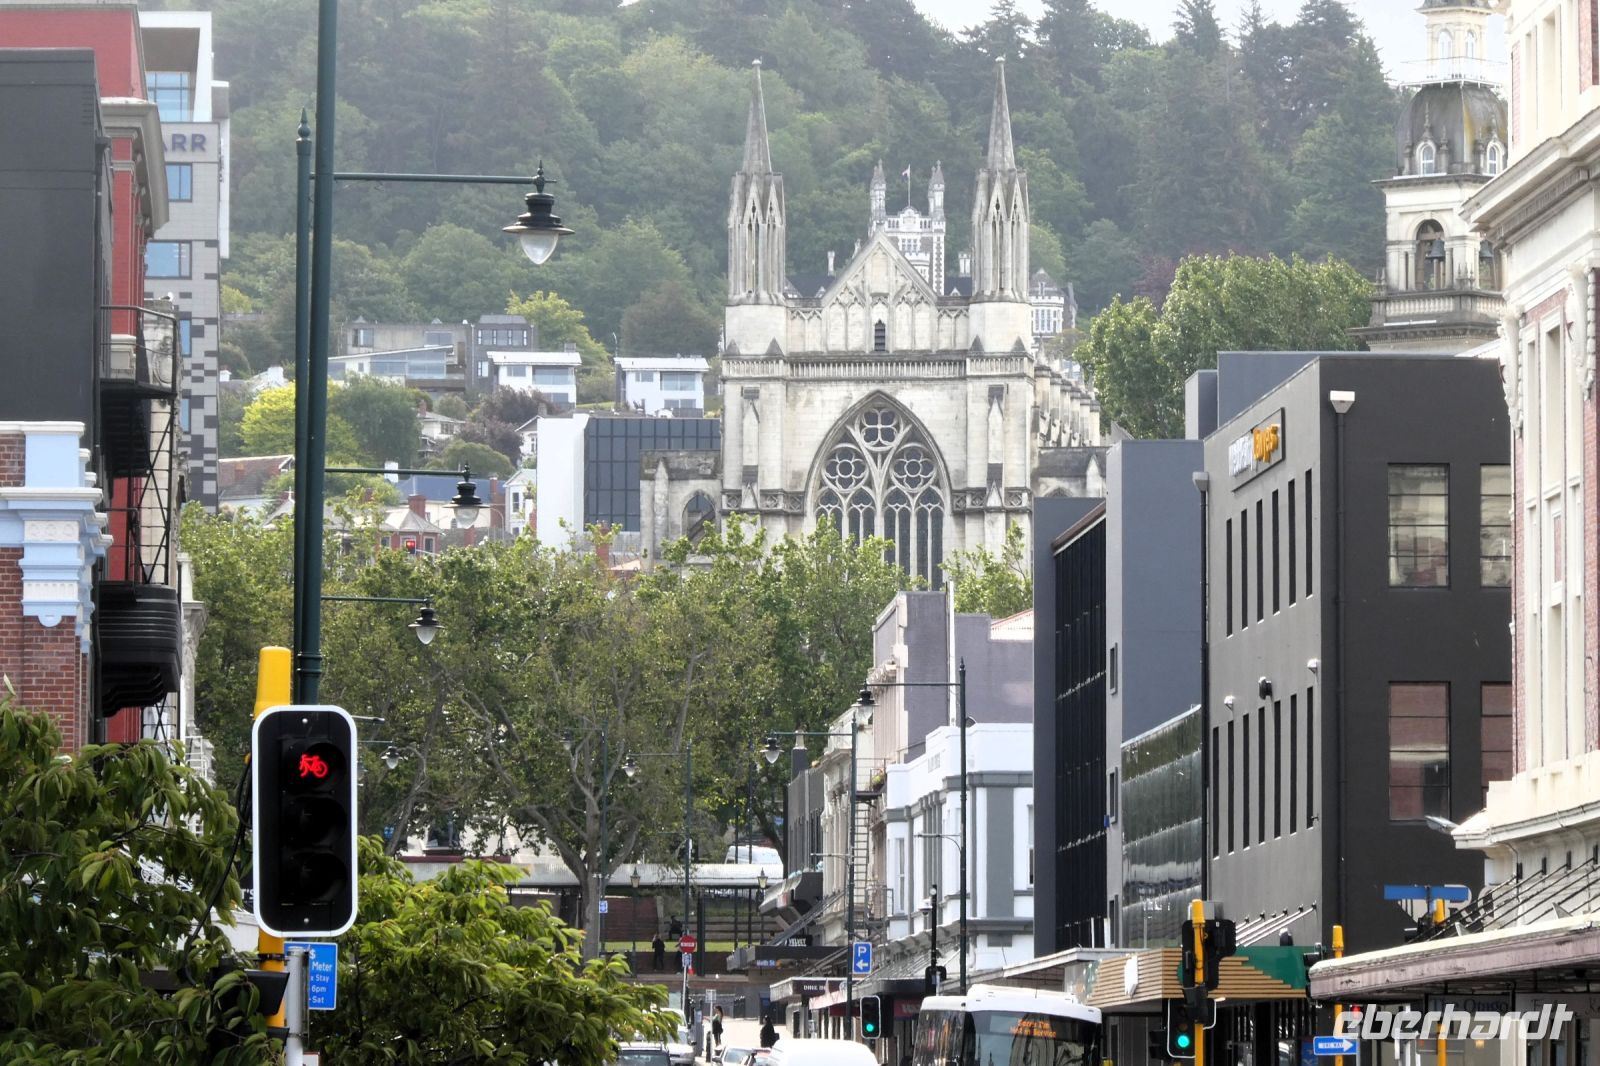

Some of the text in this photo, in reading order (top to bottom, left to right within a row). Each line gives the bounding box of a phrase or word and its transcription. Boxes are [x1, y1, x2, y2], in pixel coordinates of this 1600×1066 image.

[163, 133, 207, 152] RR
[857, 946, 867, 957] P
[312, 961, 333, 972] Meter
[315, 974, 330, 983] Stay
[311, 985, 327, 993] 6pm
[312, 995, 325, 1004] Sat
